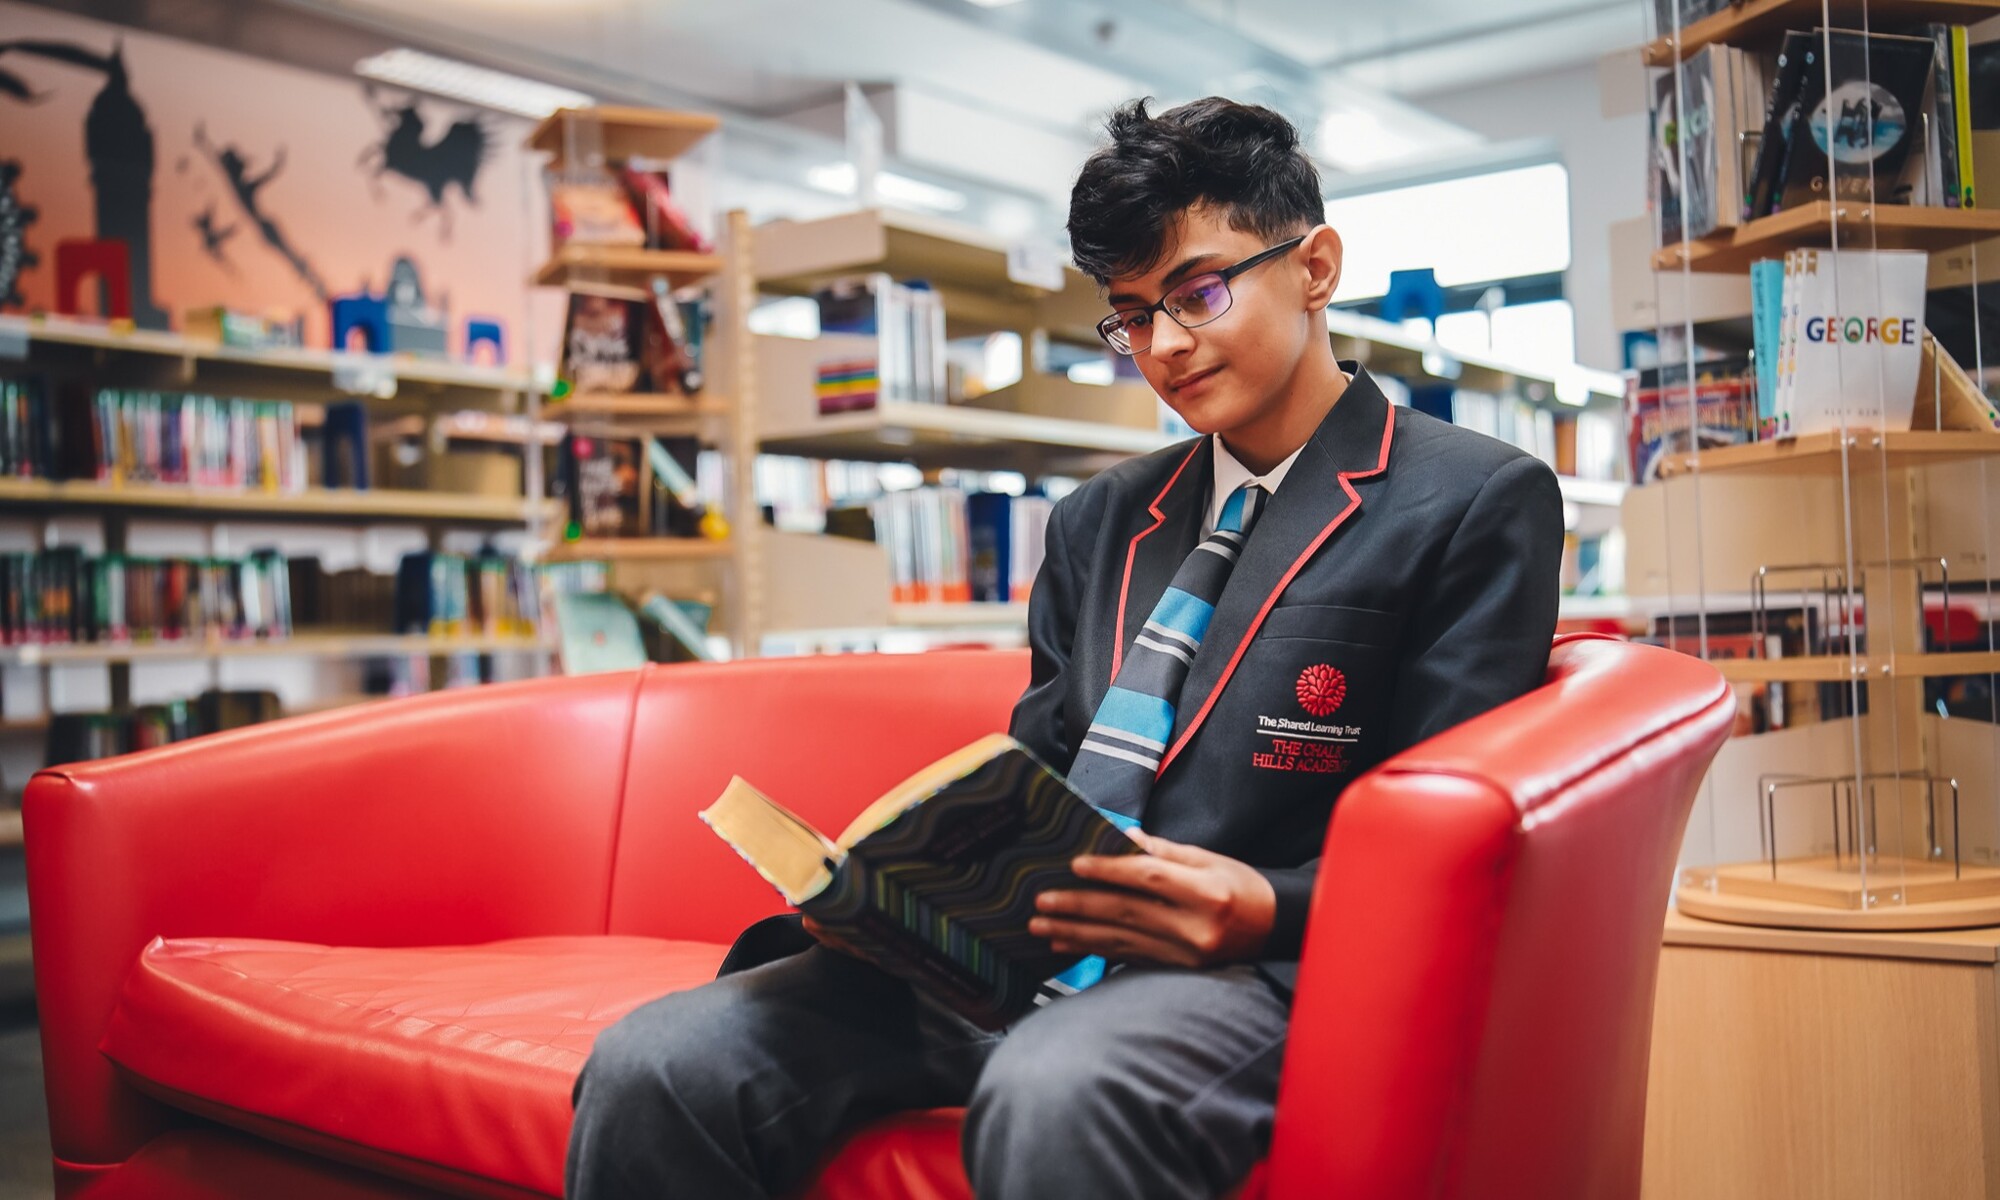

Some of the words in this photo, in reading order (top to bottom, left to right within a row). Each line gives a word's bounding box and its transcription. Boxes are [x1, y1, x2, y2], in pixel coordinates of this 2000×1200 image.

[1806, 316, 1915, 345] GEORGE
[1258, 715, 1277, 727] The
[1277, 717, 1310, 731] Shared
[1311, 722, 1344, 736] Learning
[1344, 725, 1361, 735] Trust
[1272, 739, 1303, 755] THE
[1303, 743, 1345, 758] CHALK
[1253, 752, 1295, 770] HILLS
